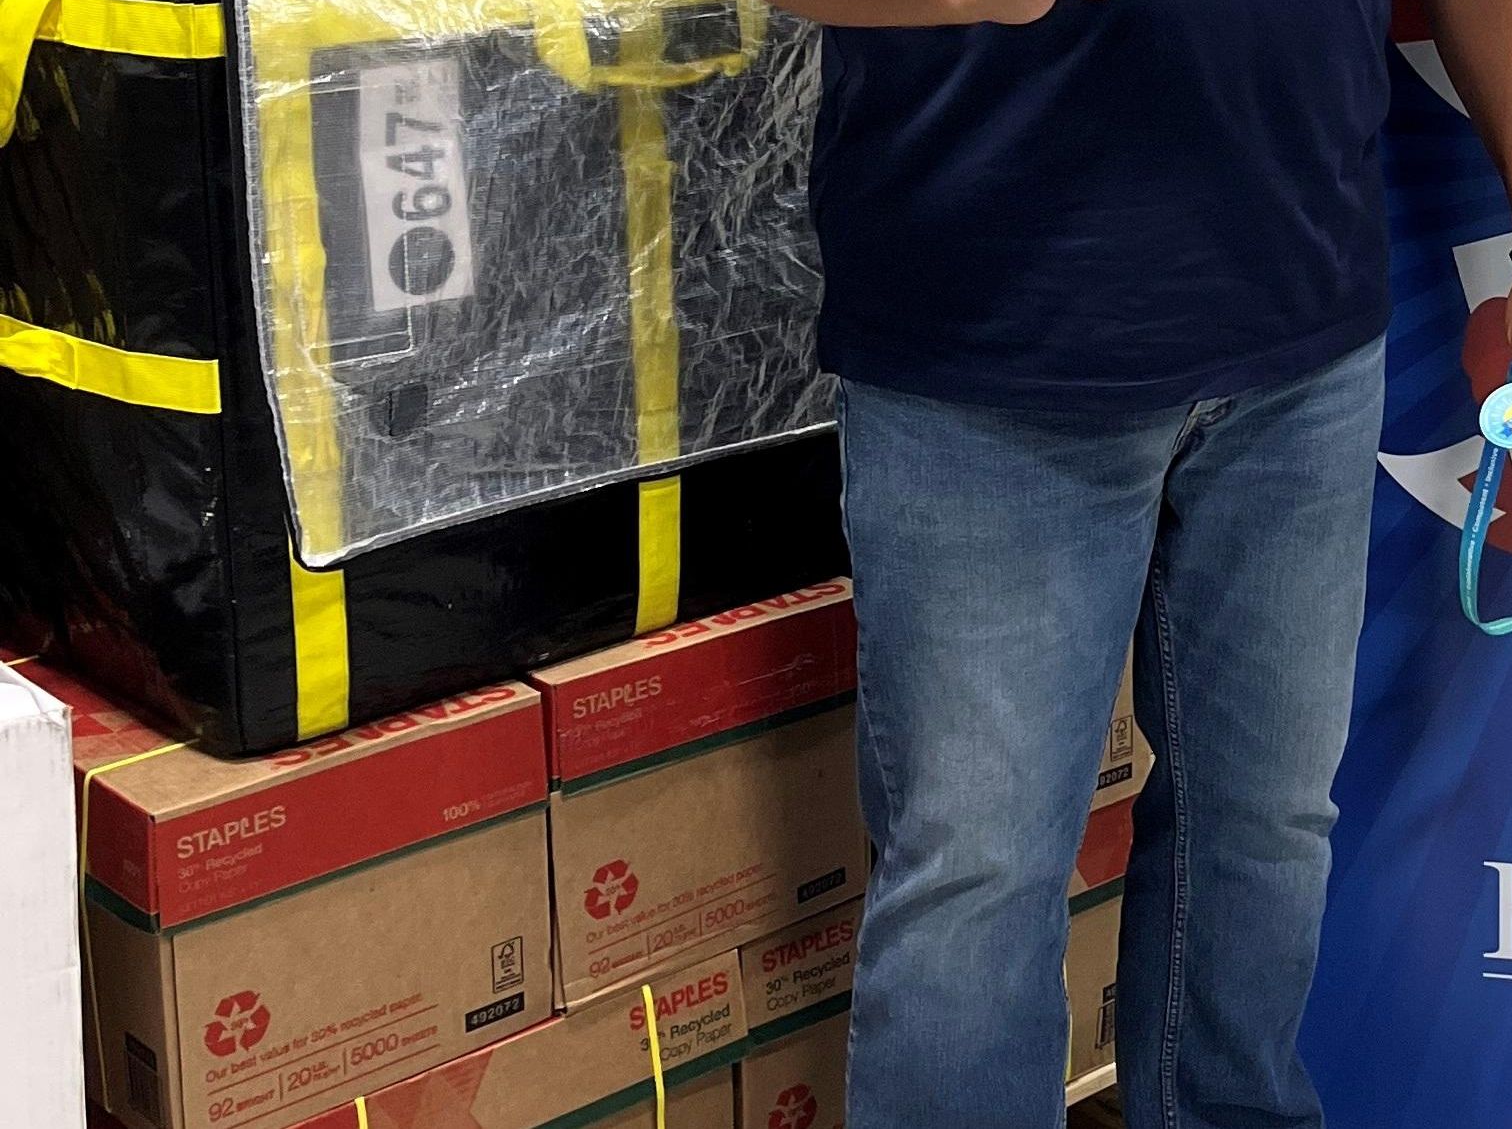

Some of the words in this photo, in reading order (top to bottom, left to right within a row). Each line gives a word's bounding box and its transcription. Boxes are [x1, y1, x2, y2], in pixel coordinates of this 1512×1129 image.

[1485, 447, 1499, 482] Inclusive
[573, 675, 663, 719] STAPLES
[443, 799, 481, 822] 100%
[177, 805, 287, 859] STAPLES
[653, 930, 674, 953] 20
[705, 899, 745, 928] 5000
[761, 920, 853, 972] STAPLES
[793, 951, 850, 984] Recycled
[470, 997, 521, 1025] 492072
[629, 972, 729, 1030] SAPLES
[767, 992, 799, 1011] Copy
[802, 976, 836, 997] Paper
[670, 1003, 730, 1039] Recycled
[696, 1023, 732, 1047] Paper
[351, 1034, 398, 1065] 5000
[205, 1067, 228, 1083] Our
[231, 1055, 257, 1074] best
[208, 1098, 235, 1122] 92
[287, 1067, 312, 1091] 20
